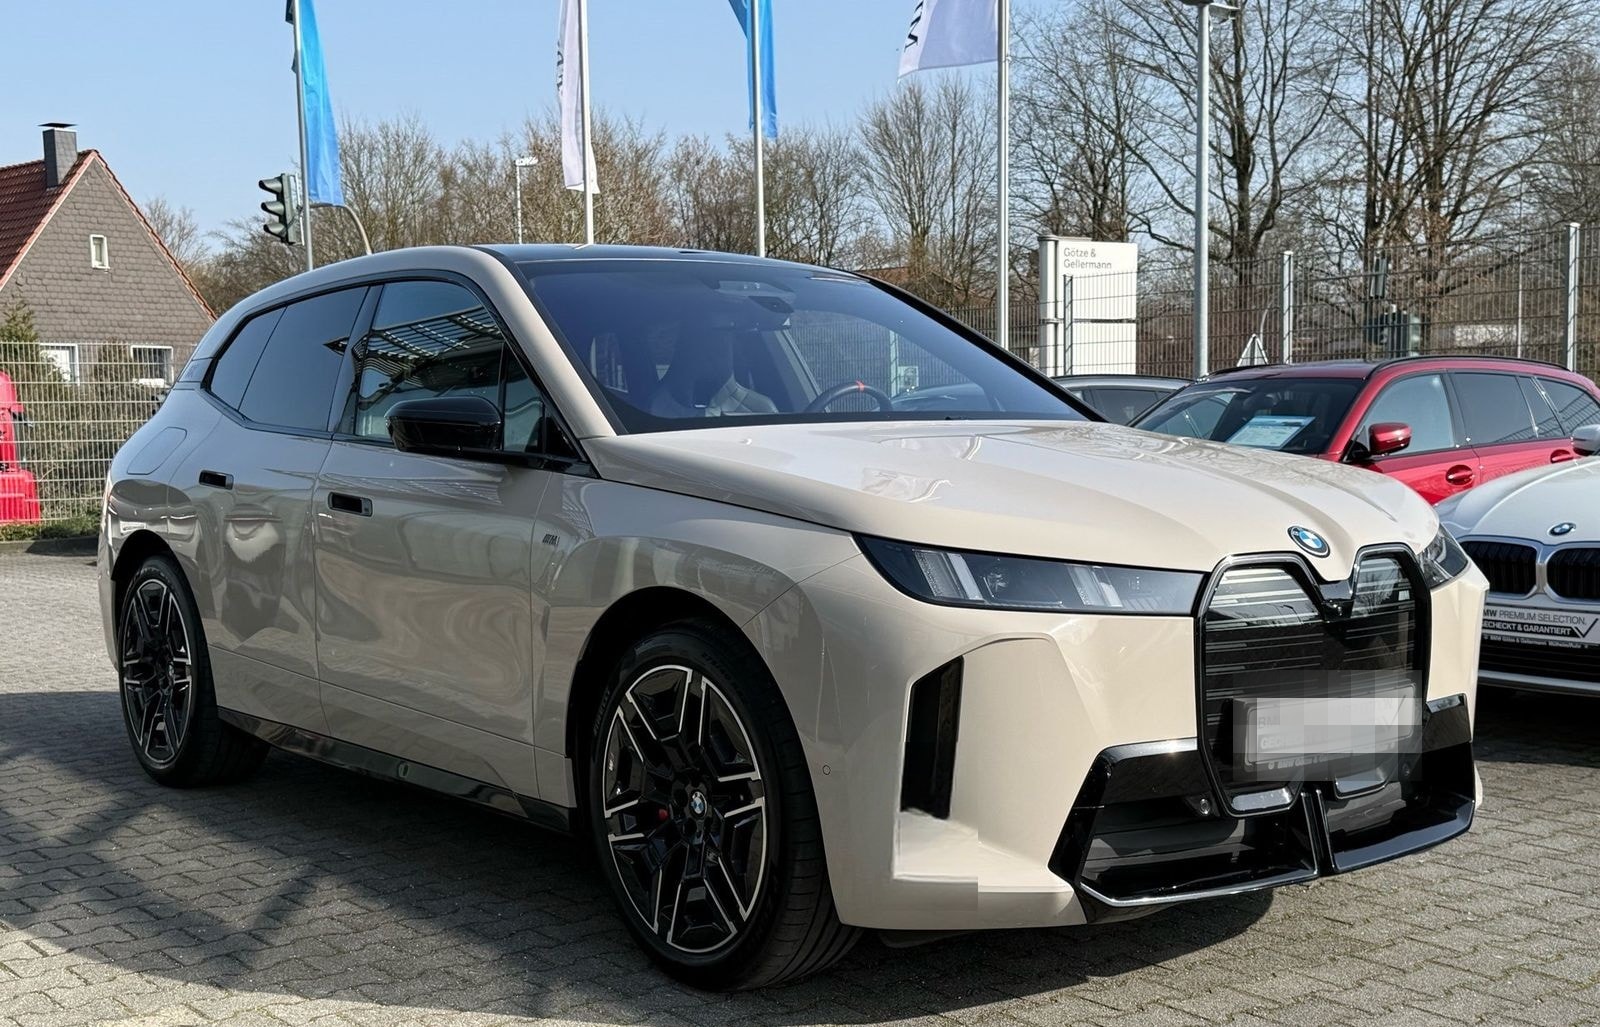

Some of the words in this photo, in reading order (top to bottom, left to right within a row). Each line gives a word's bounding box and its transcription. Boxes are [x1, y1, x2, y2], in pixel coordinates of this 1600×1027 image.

[1064, 247, 1089, 258] Götze
[1090, 248, 1097, 258] &
[1064, 259, 1112, 269] Gellermann
[1483, 609, 1497, 617] MW
[1499, 610, 1536, 621] PREMIUM
[1482, 620, 1516, 630] ECHECKT
[1517, 623, 1523, 631] &
[1524, 624, 1571, 635] GARANTIERT
